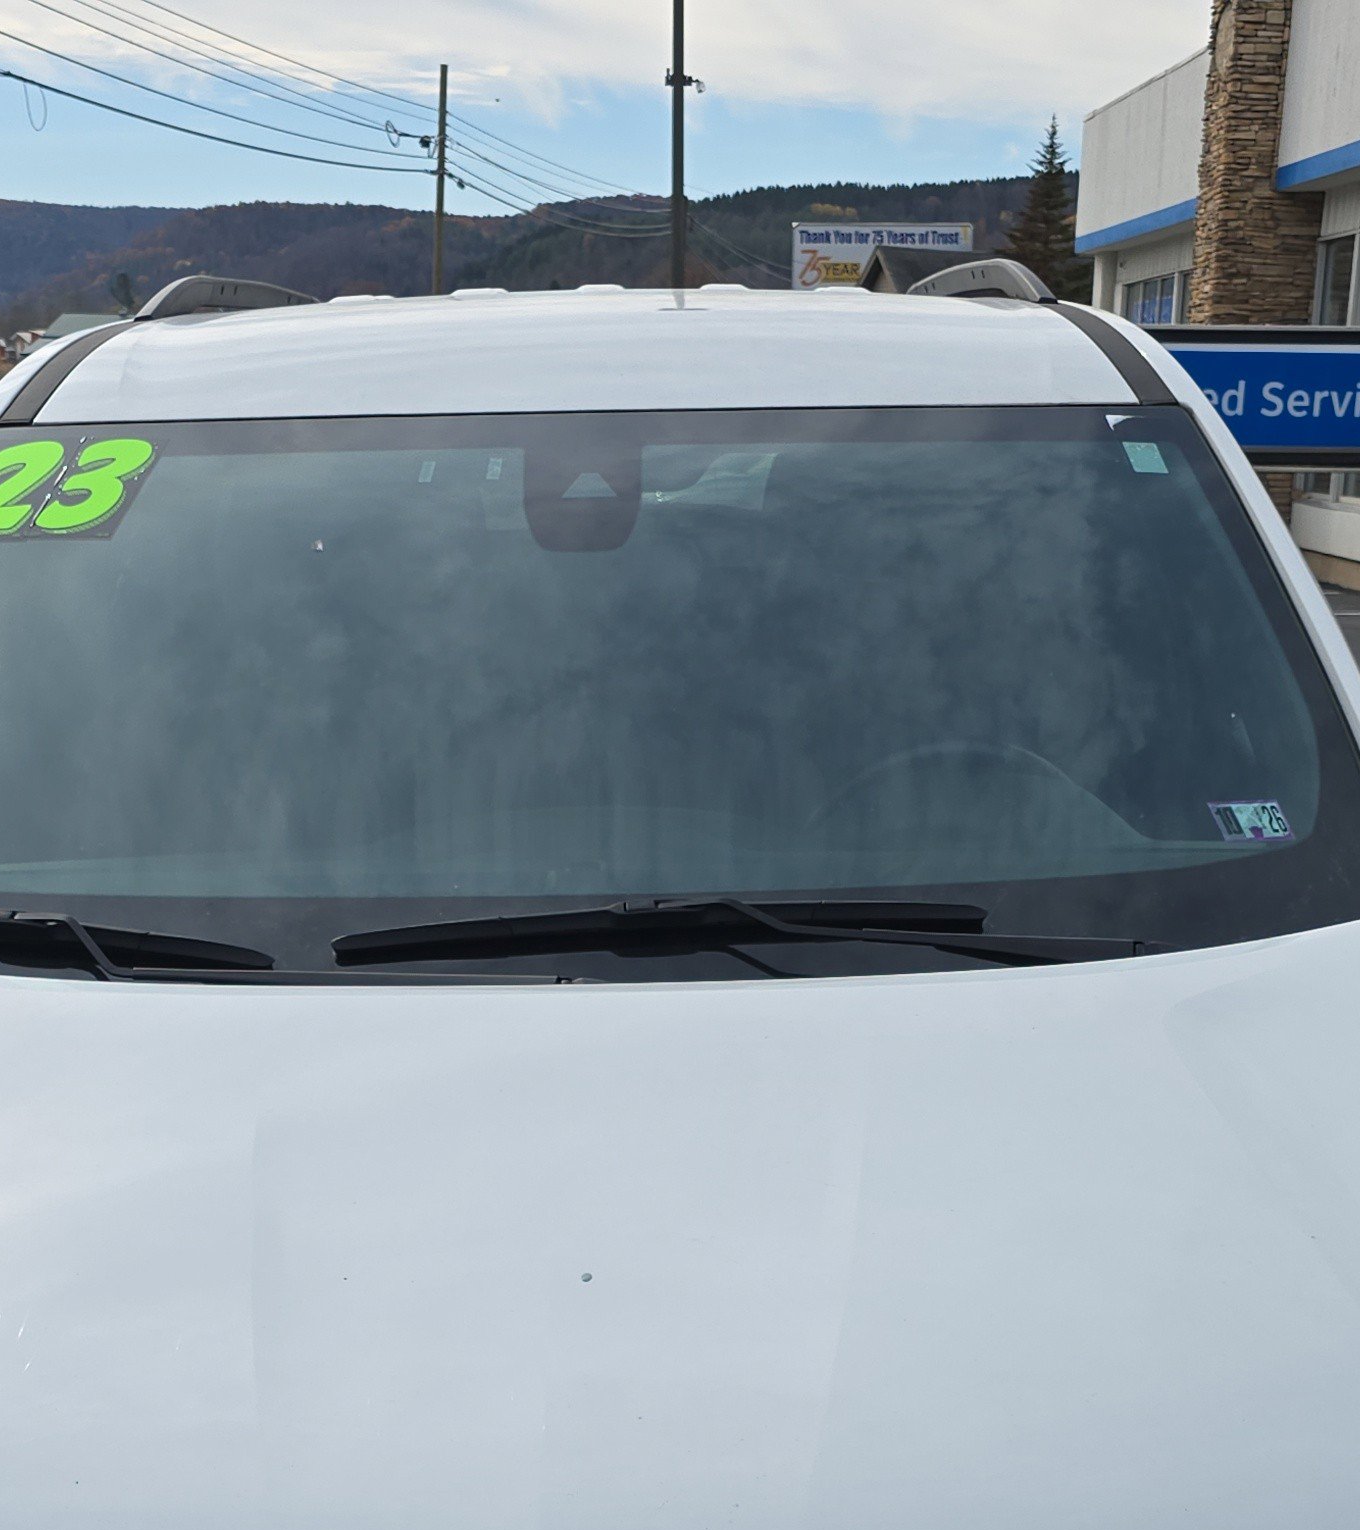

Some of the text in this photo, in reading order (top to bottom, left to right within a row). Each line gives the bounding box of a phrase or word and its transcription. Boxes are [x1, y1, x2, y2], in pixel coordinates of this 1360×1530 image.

[799, 230, 959, 244] Thank You for 75 Years of Trust
[799, 249, 860, 287] 75 YEAR
[1215, 805, 1288, 835] 10 26
